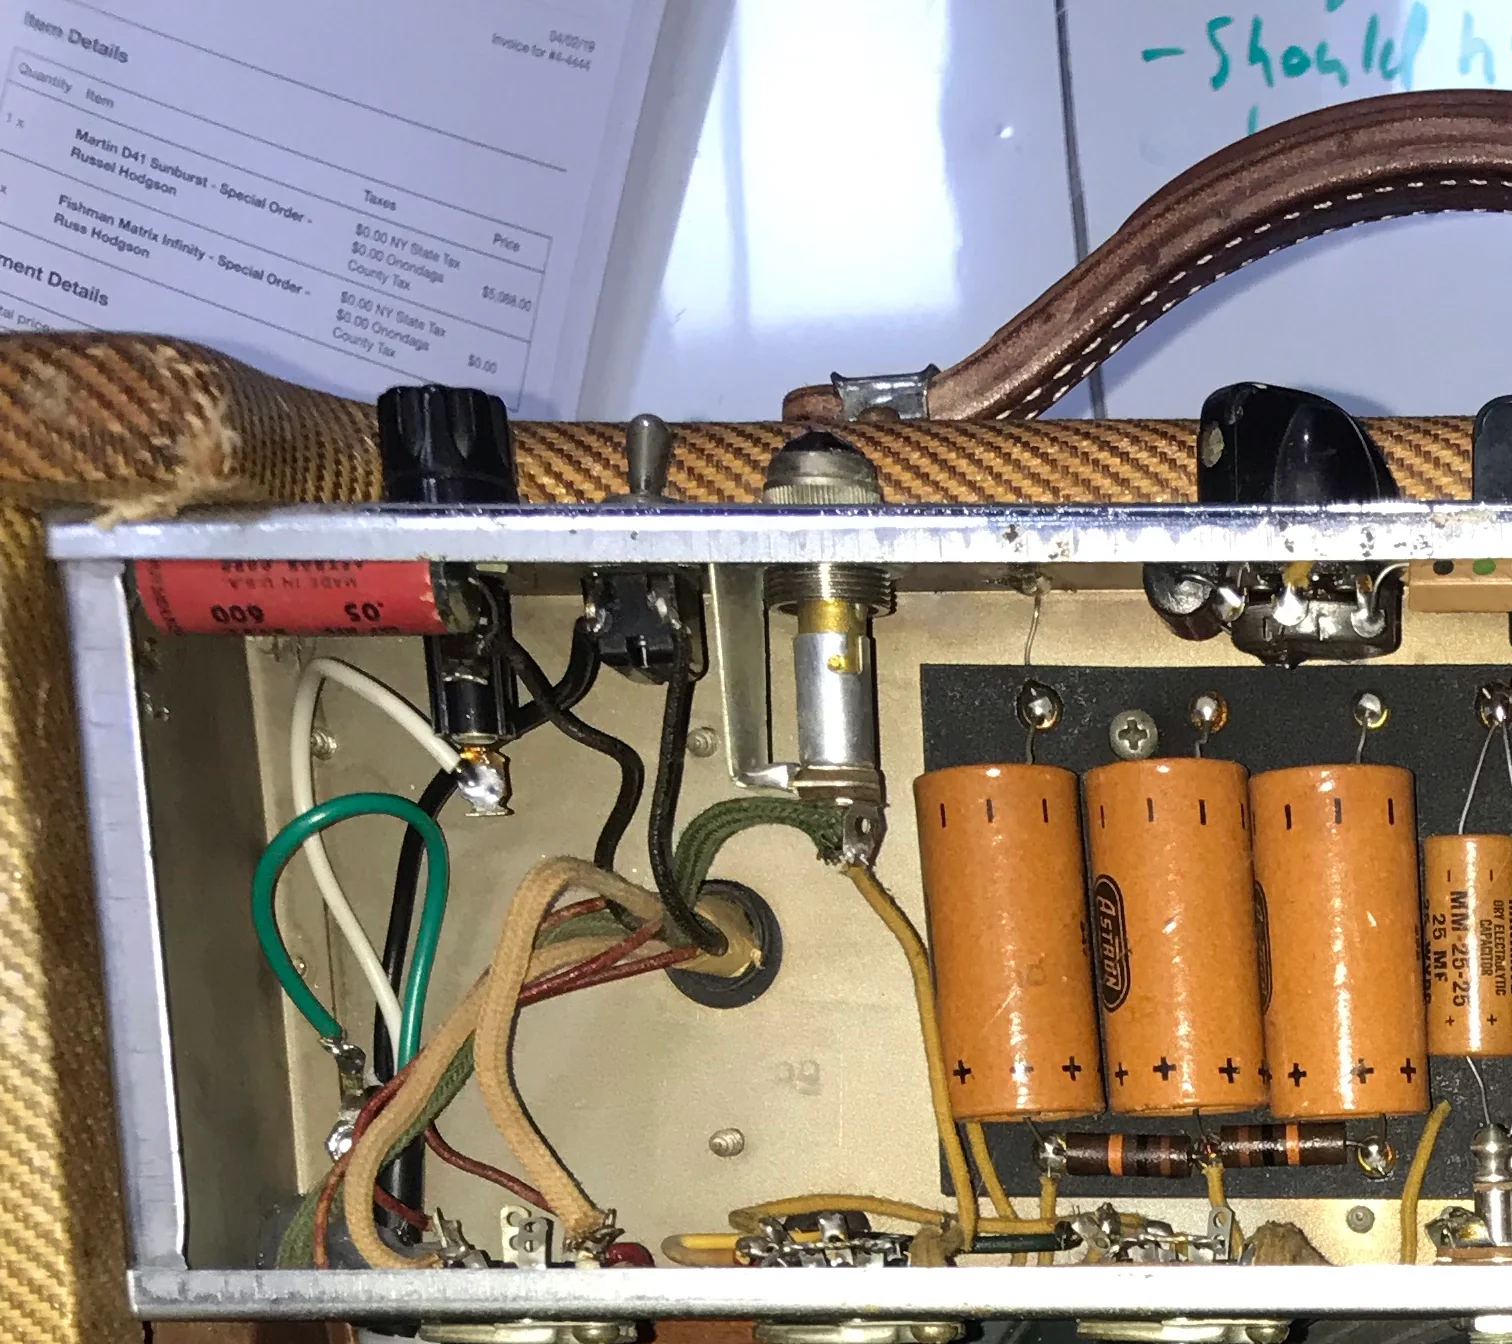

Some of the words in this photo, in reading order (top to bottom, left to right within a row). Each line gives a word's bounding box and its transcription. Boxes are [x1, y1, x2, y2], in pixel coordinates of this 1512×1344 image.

[24, 11, 63, 38] Item
[67, 28, 128, 63] Details
[18, 62, 72, 93] Quantity
[85, 88, 114, 108] Item
[70, 146, 115, 173] Russel
[118, 165, 177, 195] Hodgson
[75, 128, 118, 154] Martin
[121, 145, 146, 164] D41
[149, 157, 208, 188] Sunburst
[219, 182, 266, 209] Special
[269, 200, 304, 223] Order
[364, 189, 397, 211] Taxes
[53, 212, 87, 235] Russ
[91, 227, 150, 258] Hodgson
[58, 194, 114, 226] Fishman
[118, 218, 159, 243] Matrix
[162, 233, 206, 260] Infinity
[218, 254, 264, 281] Special
[267, 273, 303, 296] Order
[356, 223, 388, 244] $0.00
[390, 235, 408, 251] NY
[410, 242, 440, 262] State
[443, 252, 461, 270] Tax
[493, 232, 521, 252] Price
[347, 259, 389, 285] County
[392, 274, 411, 291] Tax
[351, 241, 384, 262] $0.00
[386, 254, 444, 283] Onondaga
[48, 271, 109, 307] Details
[336, 308, 369, 330] $0.00
[371, 321, 430, 352] Onondaga
[340, 291, 373, 312] $0.00
[375, 303, 394, 319] NY
[396, 310, 426, 331] State
[429, 320, 446, 338] Tax
[332, 326, 374, 352] County
[378, 341, 396, 359] Tax
[468, 354, 498, 374] $0.00
[1096, 895, 1120, 990] ASTRON
[1432, 913, 1446, 940] 25
[1480, 919, 1492, 975] CAPACITOR
[1433, 950, 1447, 982] MF
